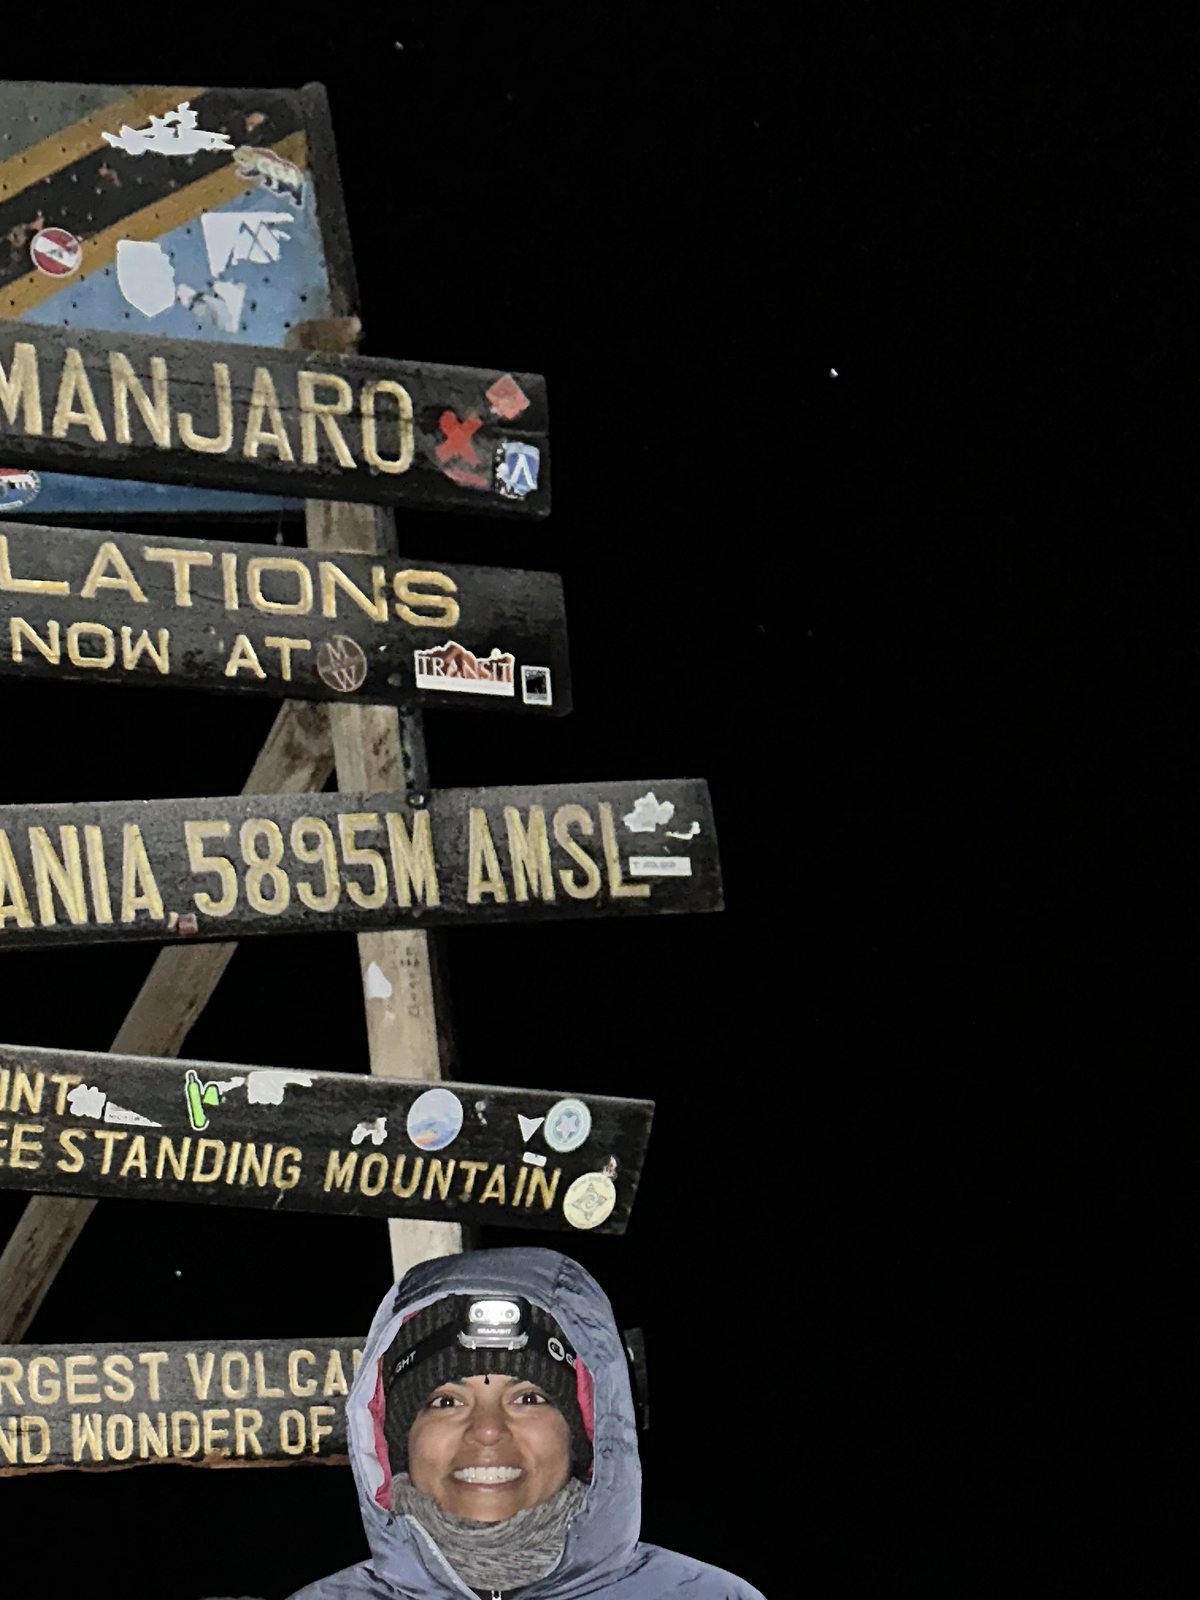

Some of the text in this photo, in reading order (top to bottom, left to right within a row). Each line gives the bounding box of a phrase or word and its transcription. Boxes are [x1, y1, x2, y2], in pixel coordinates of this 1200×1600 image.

[9, 616, 170, 675] NOW
[224, 633, 312, 682] AT
[417, 655, 511, 683] TRANSIT
[185, 808, 440, 917] 5895M
[467, 801, 651, 904] AMSL
[55, 1127, 303, 1190] STANDING
[323, 1150, 563, 1211] MOUNTAIN
[68, 1407, 262, 1463] WONDER
[279, 1405, 336, 1455] OF
